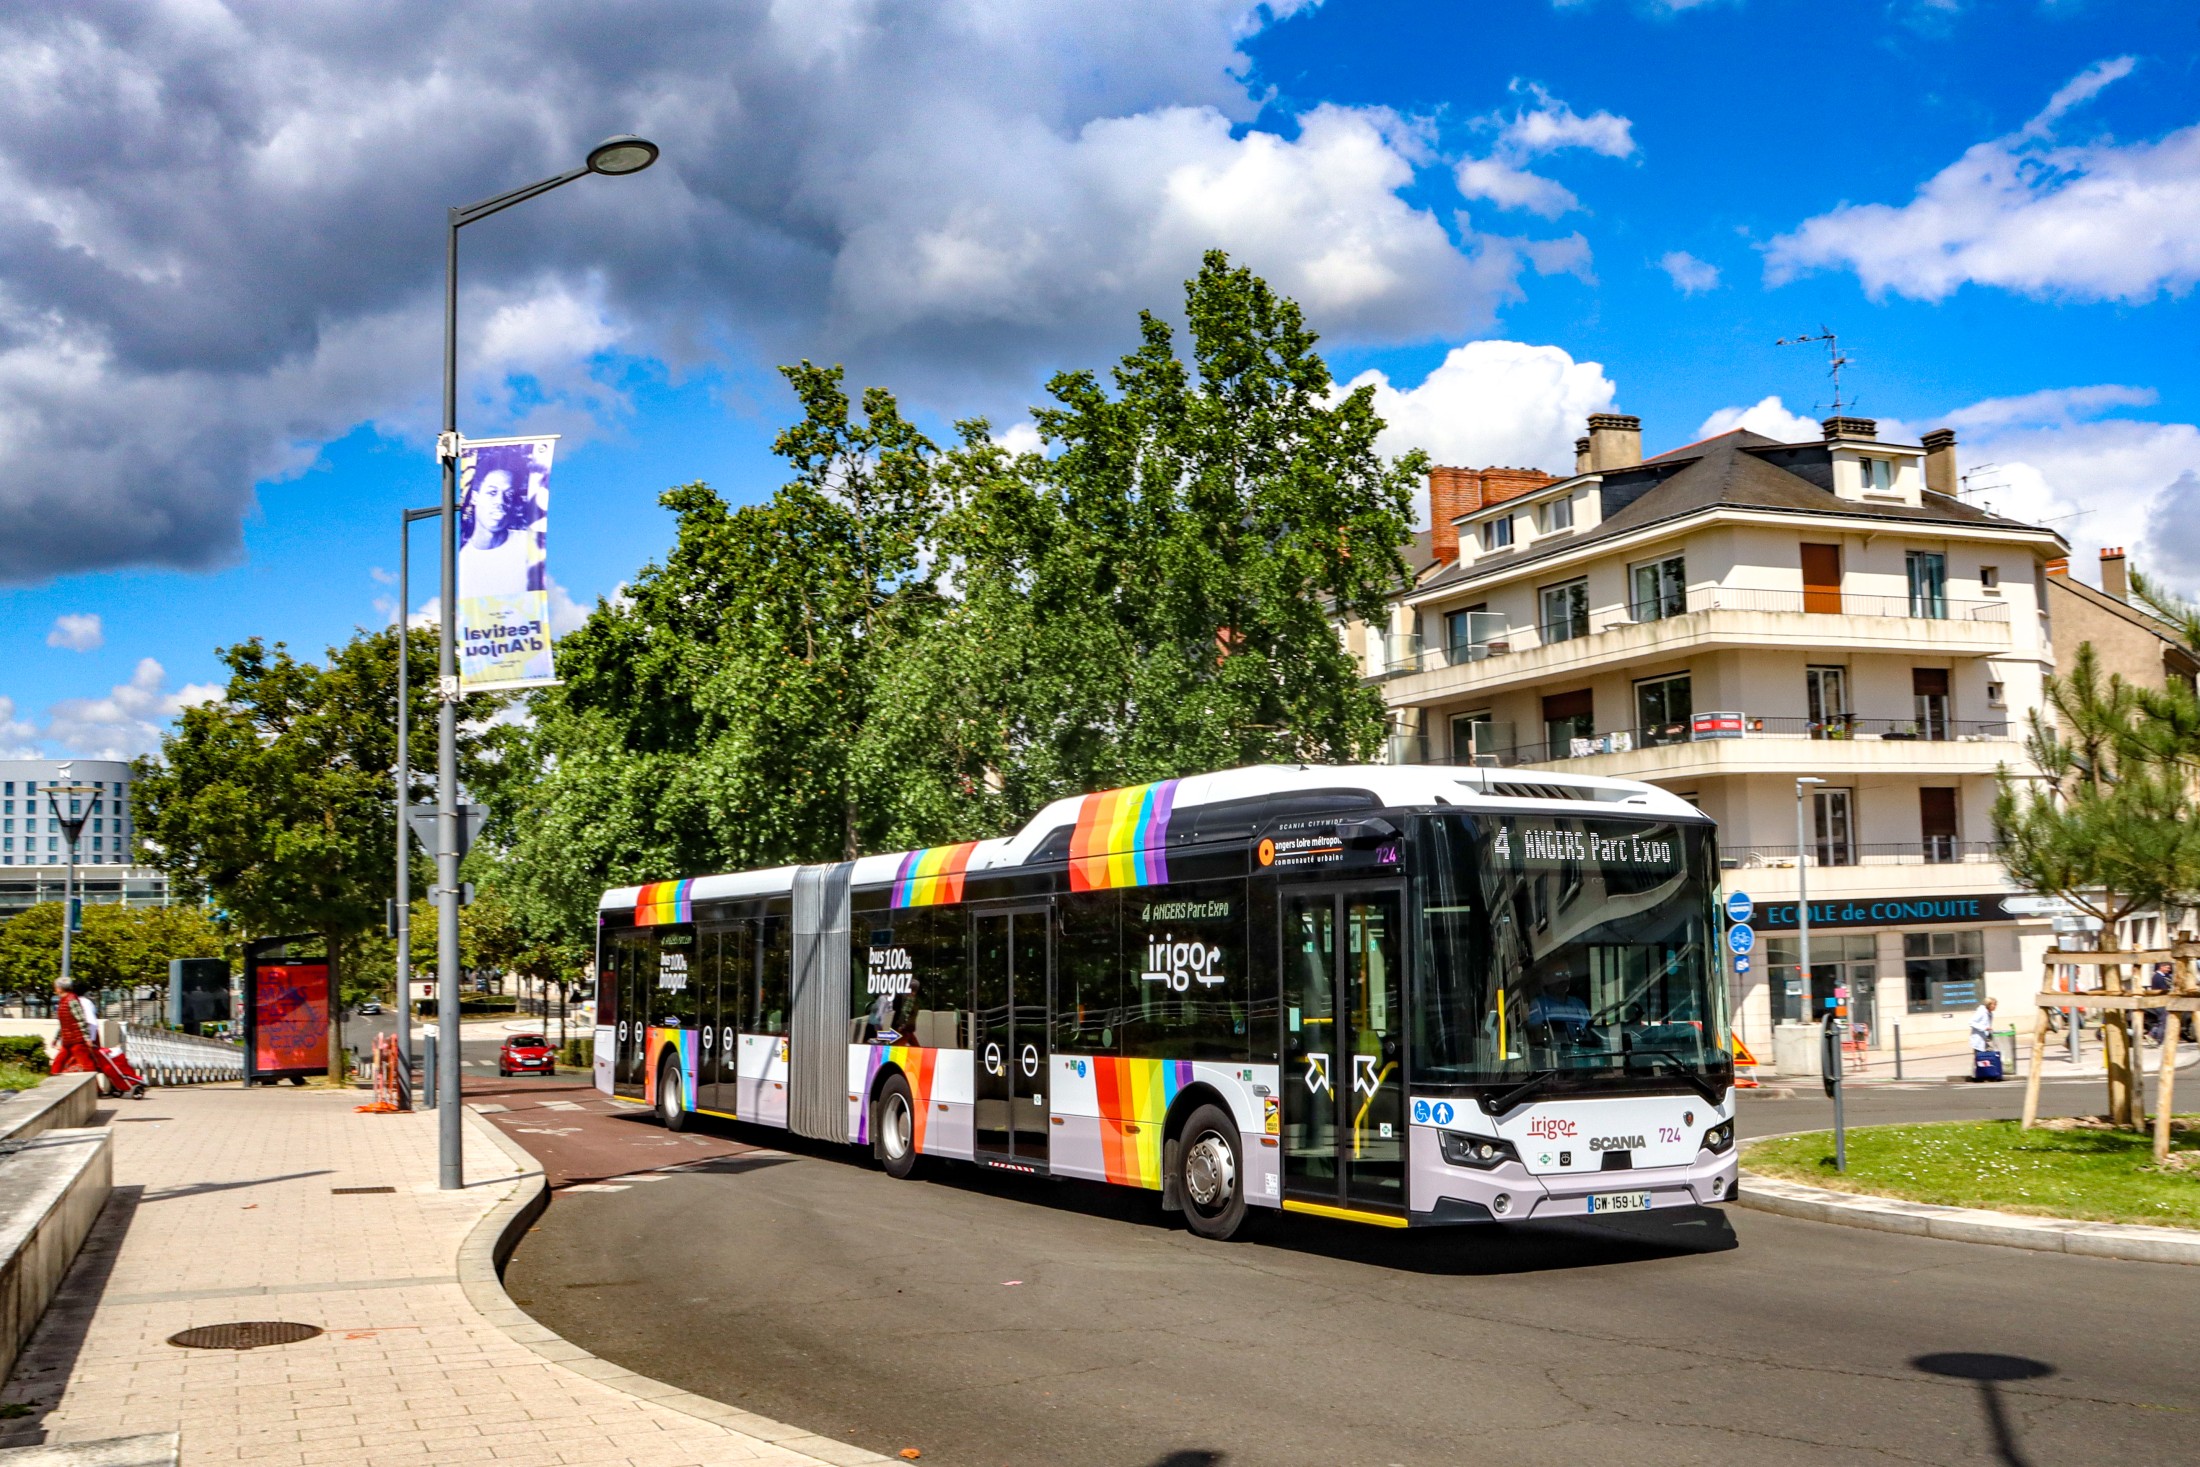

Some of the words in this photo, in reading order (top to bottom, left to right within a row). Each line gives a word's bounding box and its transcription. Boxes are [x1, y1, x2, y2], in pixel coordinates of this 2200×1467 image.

[1279, 822, 1305, 831] SCANIA
[1275, 840, 1296, 852] angers
[1311, 836, 1343, 848] métropol
[1494, 826, 1511, 860] 4
[1524, 829, 1586, 860] ANGERS
[1589, 832, 1628, 862] Parc
[1631, 834, 1671, 863] Expo
[1274, 856, 1315, 866] communauté
[1317, 853, 1344, 863] urbaine
[1375, 846, 1397, 864] 724
[1142, 903, 1151, 922] 4
[1153, 902, 1186, 921] ANGERS
[1187, 901, 1207, 919] Parc
[1208, 900, 1229, 917] Expo
[1767, 904, 1838, 924] ECOLE
[1841, 902, 1866, 920] de
[1870, 899, 1980, 920] CONDUITE
[869, 947, 884, 965] bus
[884, 948, 912, 970] 100%
[659, 967, 688, 996] biogaz
[867, 966, 913, 1002] biogaz
[1528, 1116, 1577, 1140] irigo
[1658, 1127, 1681, 1143] 724
[1589, 1135, 1646, 1152] SCANIA
[1594, 1194, 1645, 1211] GW-159-LX
